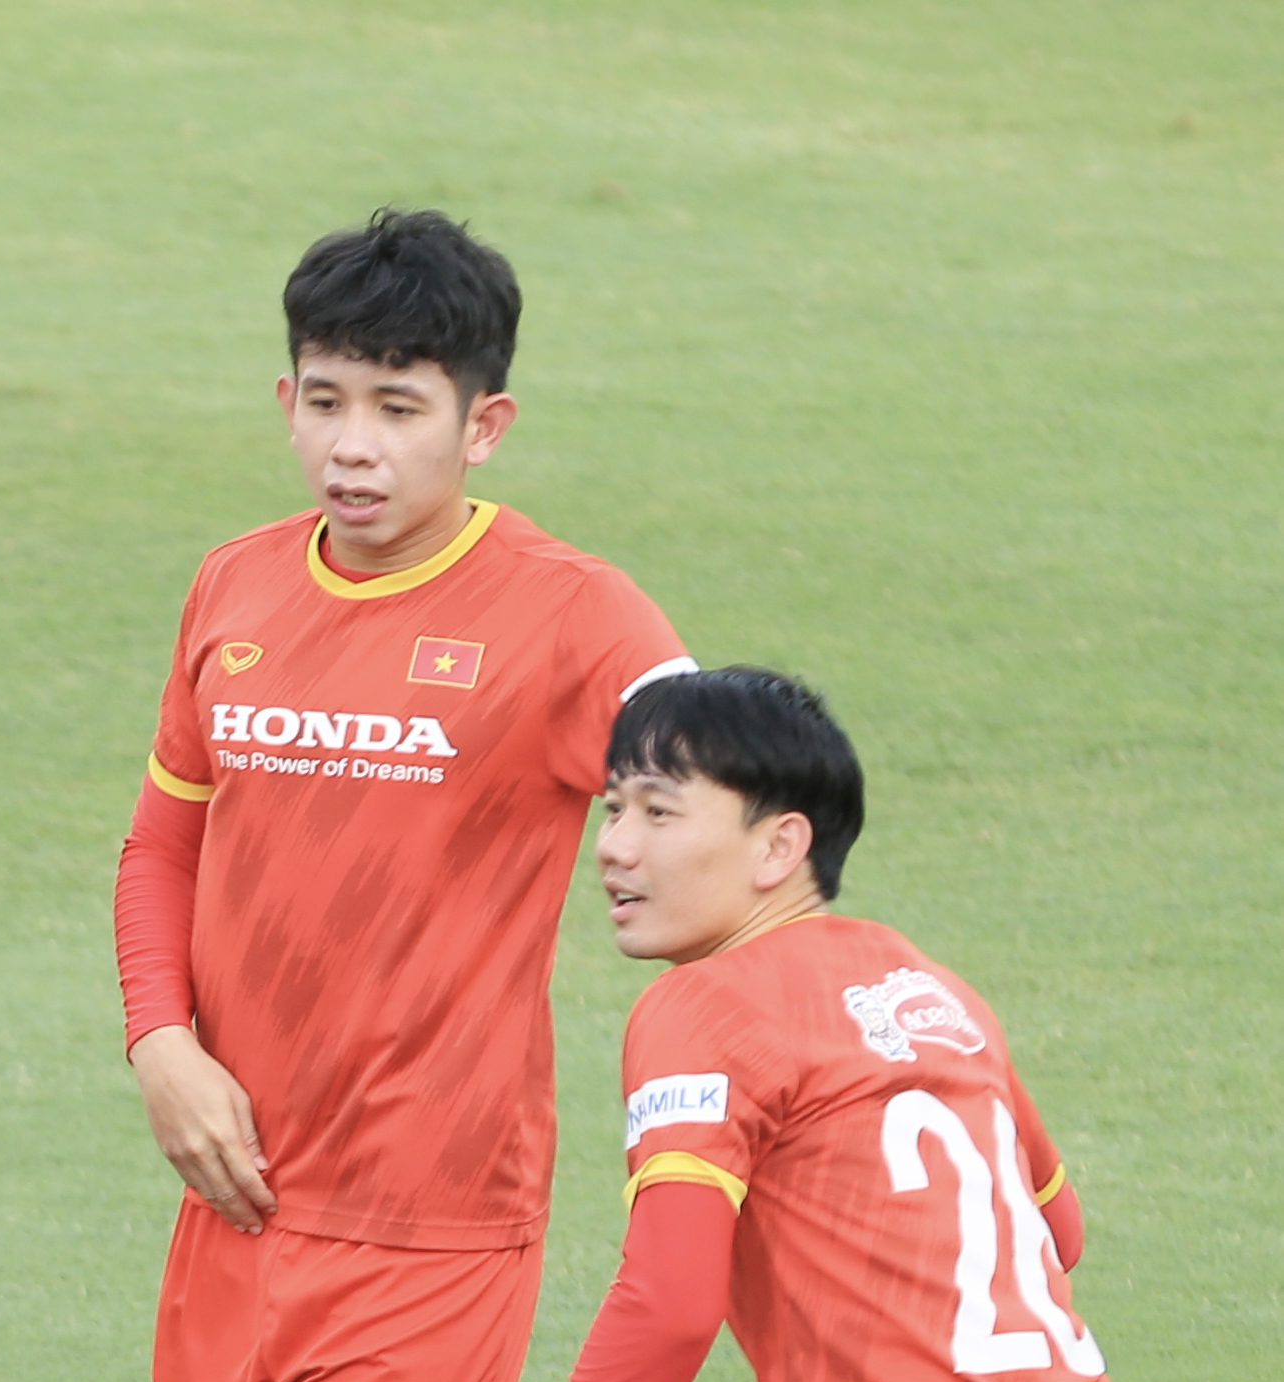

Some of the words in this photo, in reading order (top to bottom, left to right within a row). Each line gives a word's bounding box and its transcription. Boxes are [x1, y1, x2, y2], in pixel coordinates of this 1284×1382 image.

[210, 703, 459, 758] HONDA
[216, 749, 249, 771] The
[251, 751, 321, 776] Power
[322, 757, 349, 778] of
[351, 758, 445, 785] Dreams
